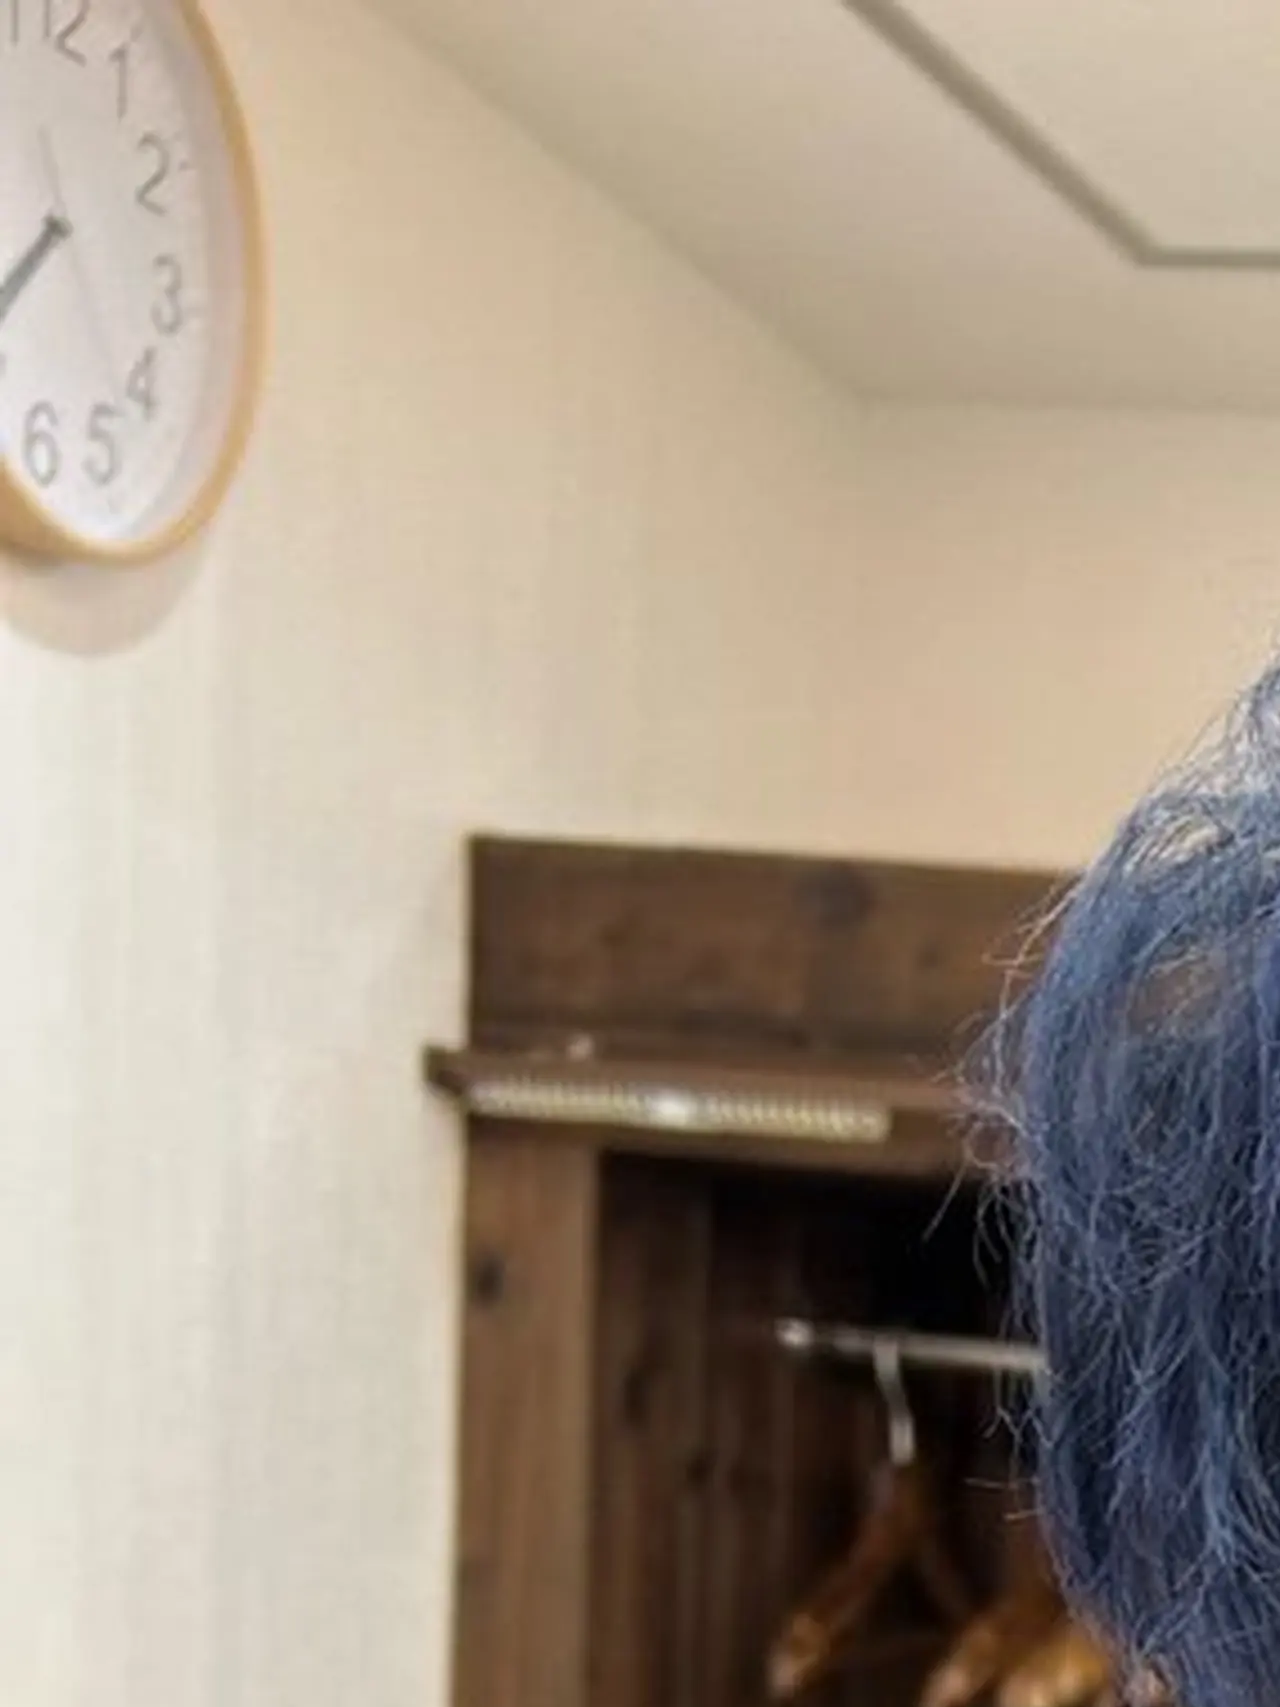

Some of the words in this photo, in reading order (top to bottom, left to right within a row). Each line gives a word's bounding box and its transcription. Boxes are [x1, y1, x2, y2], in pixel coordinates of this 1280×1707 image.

[108, 45, 128, 118] 1
[135, 132, 170, 216] 2
[151, 253, 184, 337] 3
[126, 346, 157, 421] 4
[22, 400, 61, 488] 6
[82, 403, 123, 486] 5
